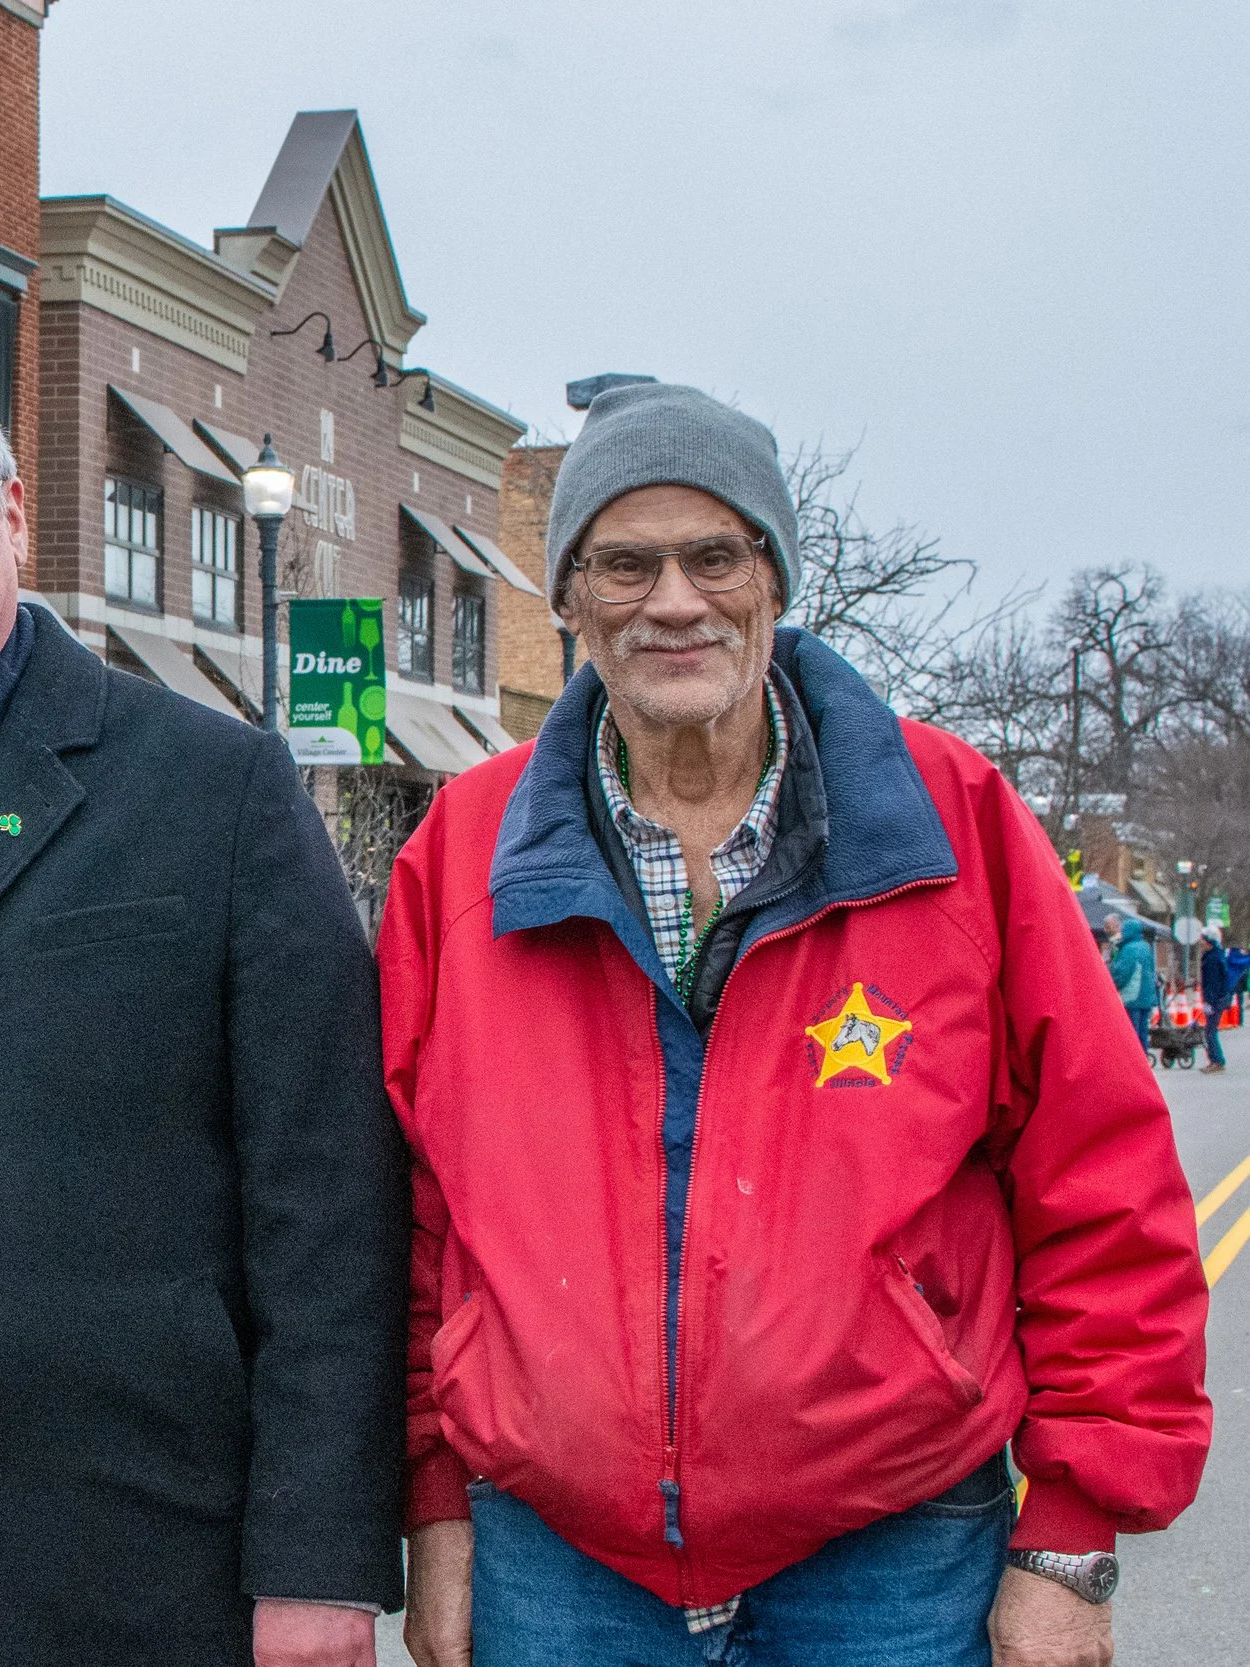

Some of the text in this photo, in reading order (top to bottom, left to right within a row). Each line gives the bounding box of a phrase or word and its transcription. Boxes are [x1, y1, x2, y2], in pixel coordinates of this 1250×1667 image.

[293, 651, 362, 674] Dine
[295, 702, 330, 712] center
[292, 710, 332, 723] yourself
